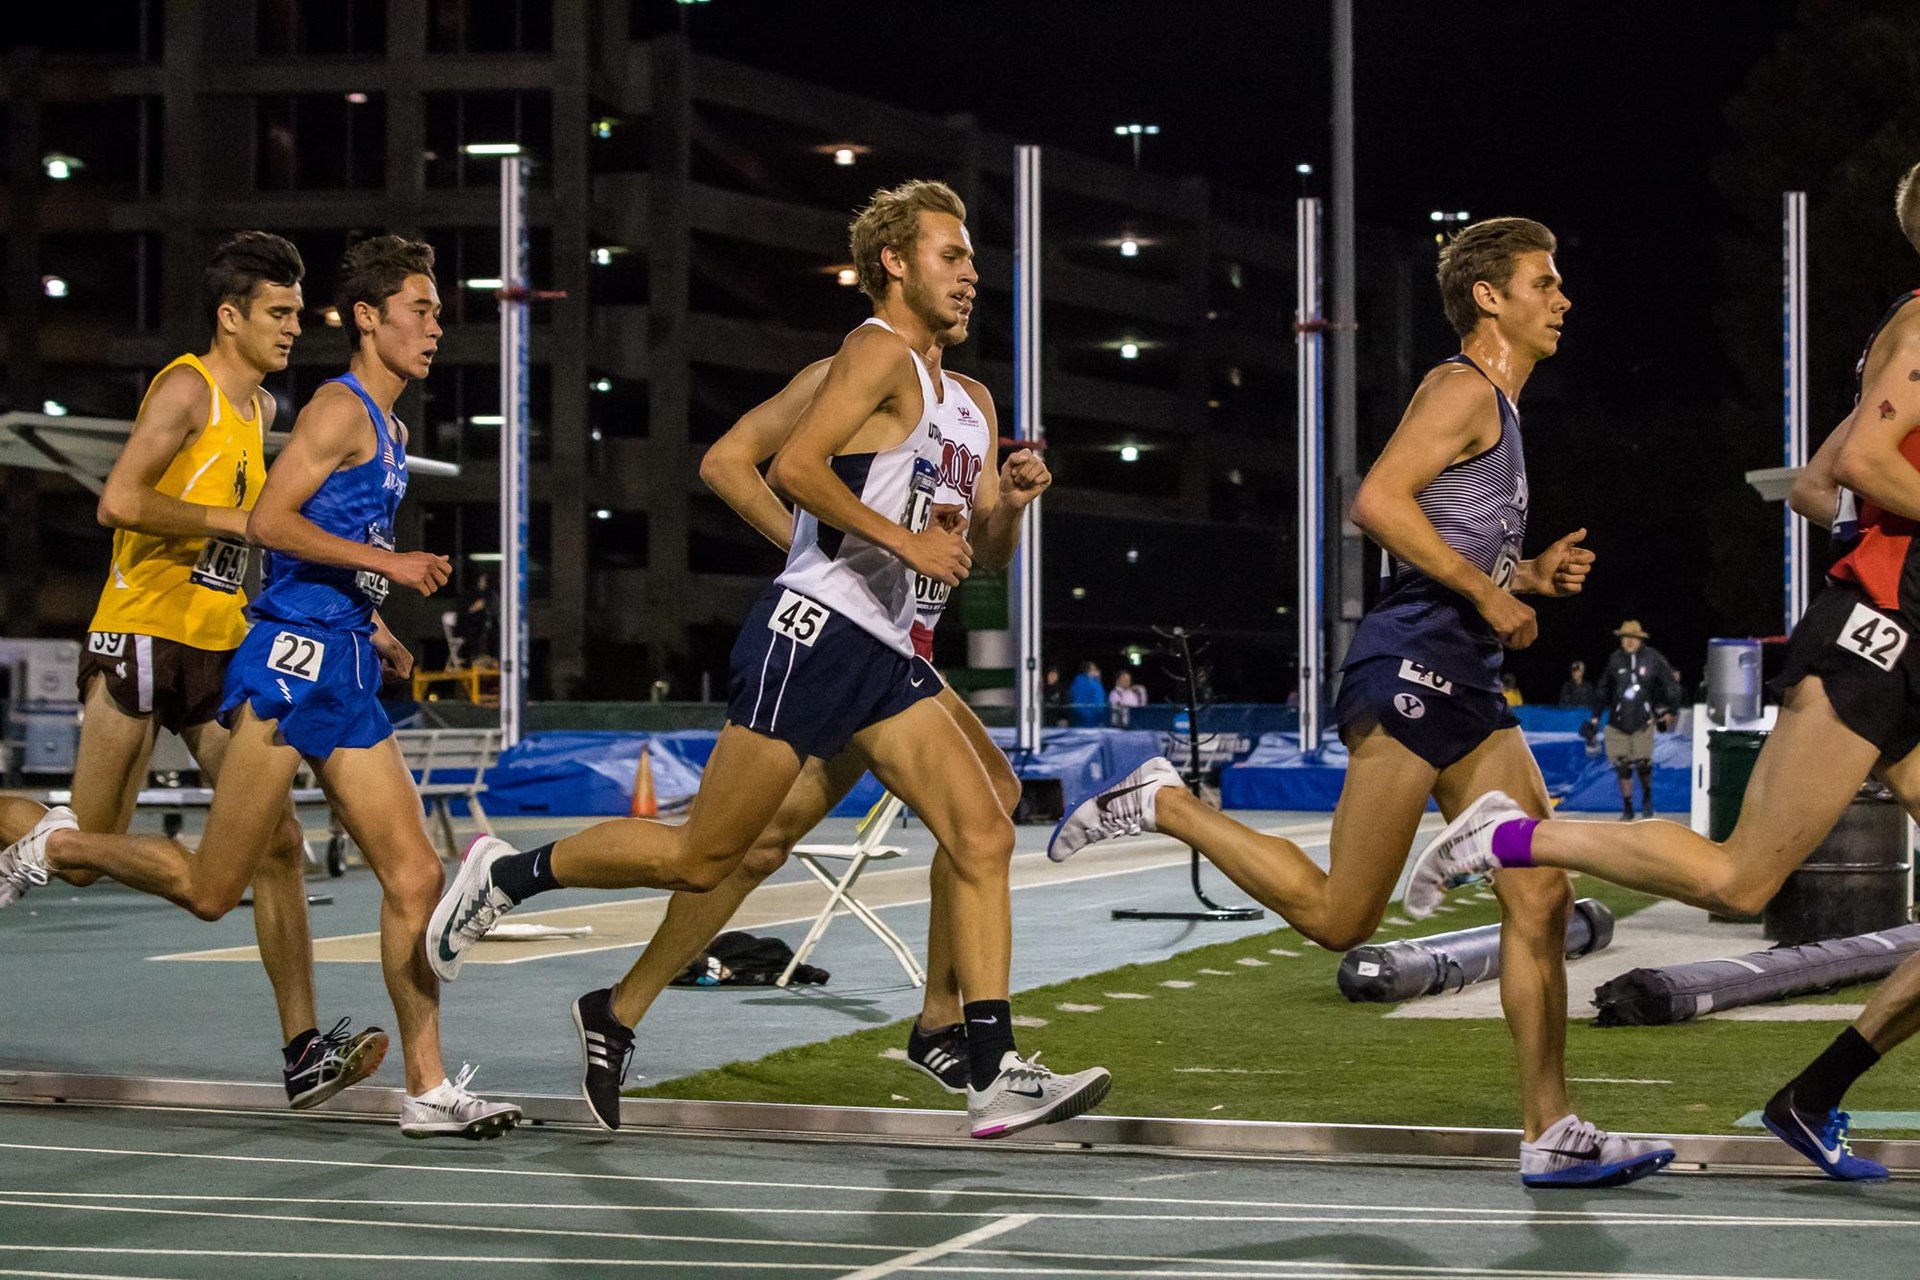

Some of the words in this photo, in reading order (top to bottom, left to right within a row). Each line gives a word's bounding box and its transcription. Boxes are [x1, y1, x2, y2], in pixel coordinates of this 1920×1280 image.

[777, 599, 823, 640] 45
[275, 633, 317, 677] 22
[1850, 617, 1901, 666] 42
[1401, 695, 1421, 716] Y
